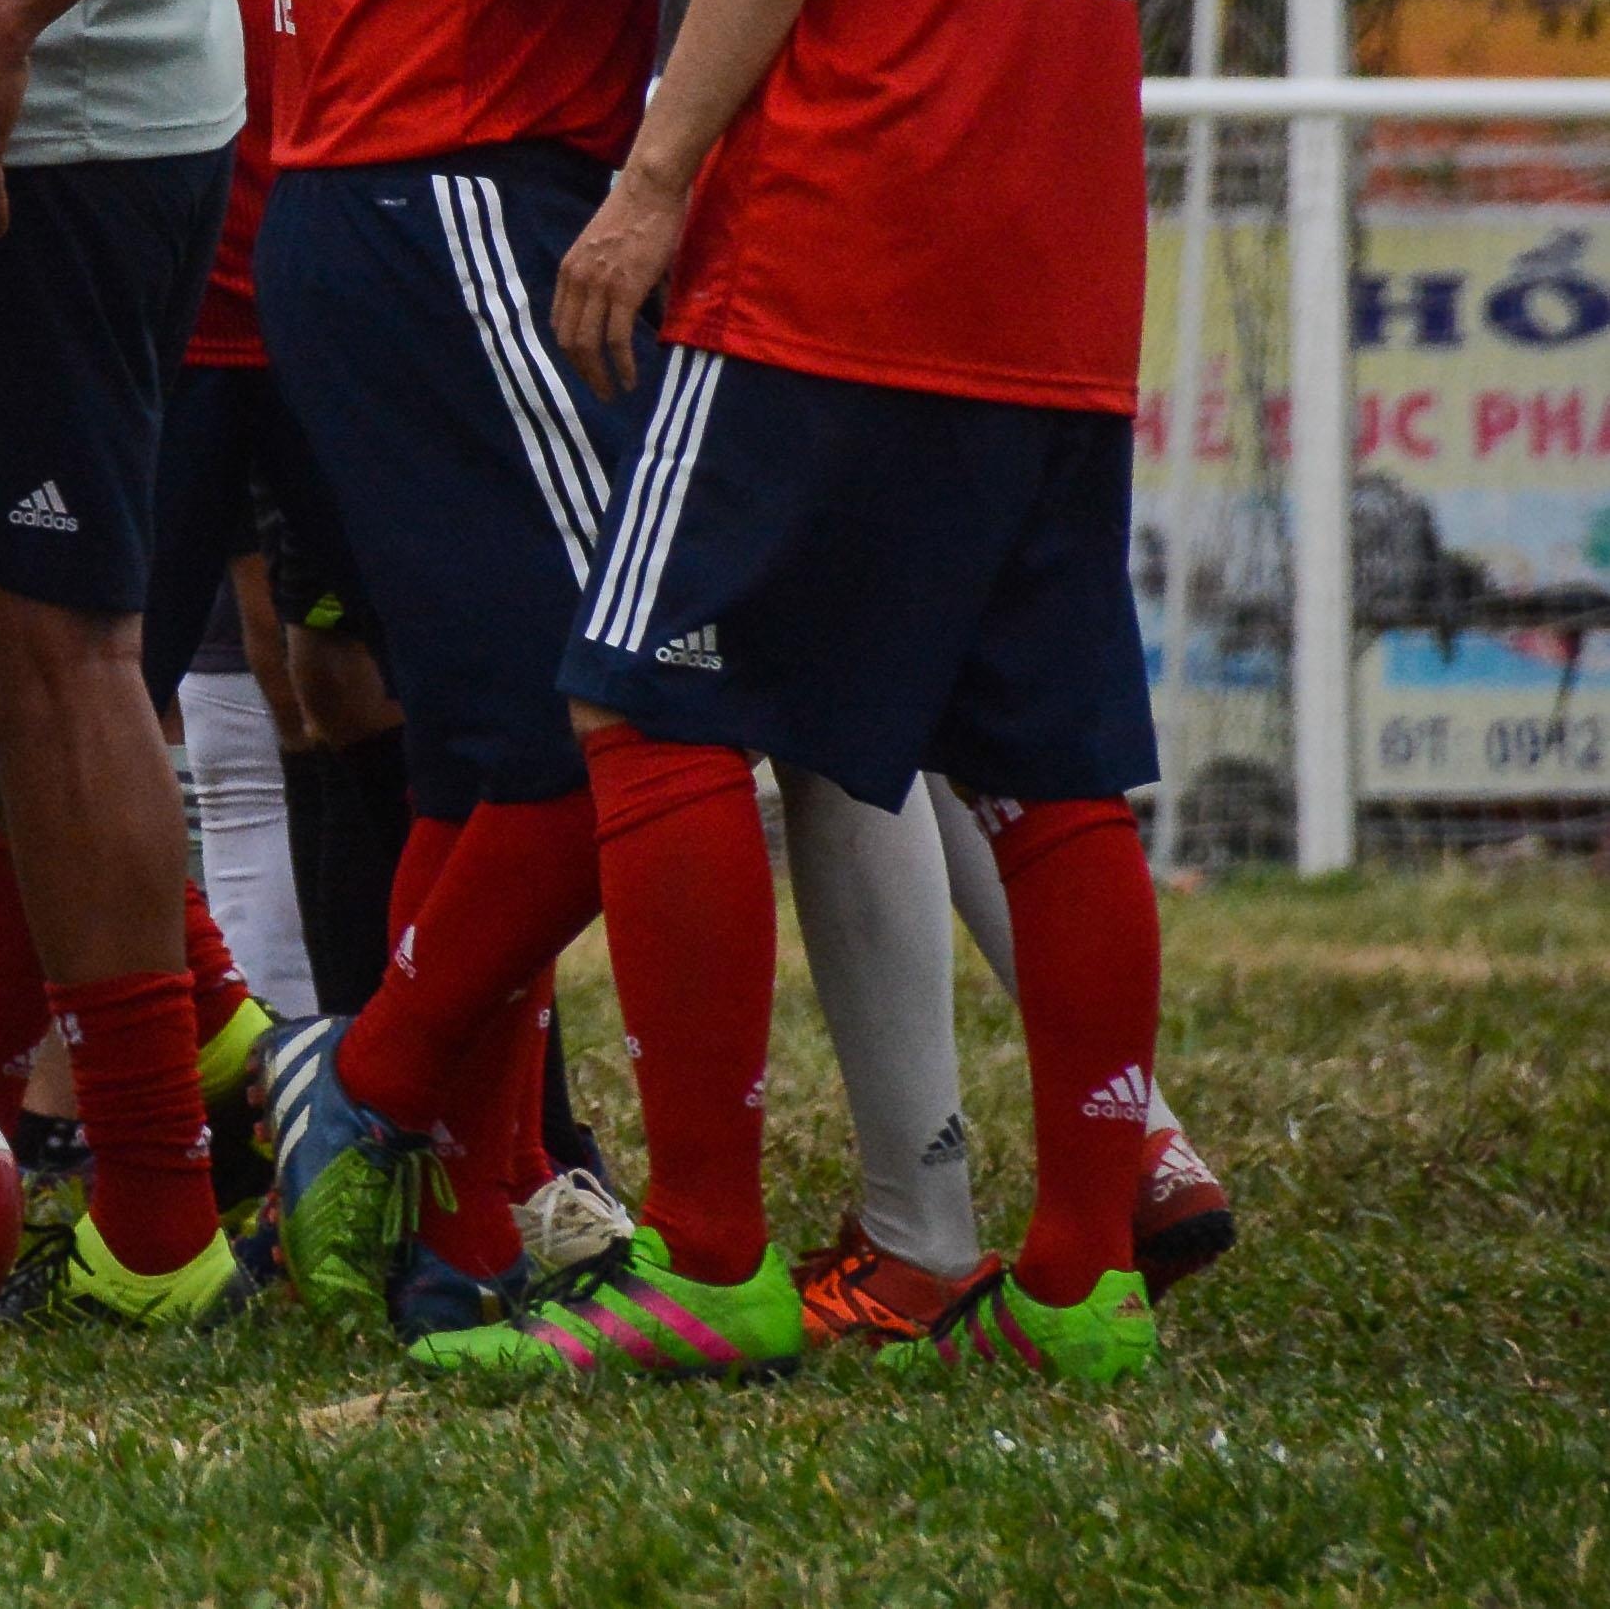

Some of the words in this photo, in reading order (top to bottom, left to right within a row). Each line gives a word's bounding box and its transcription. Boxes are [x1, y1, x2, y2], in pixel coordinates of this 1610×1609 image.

[9, 504, 78, 532] adidas
[655, 646, 723, 670] adidas
[1082, 1098, 1147, 1123] adida
